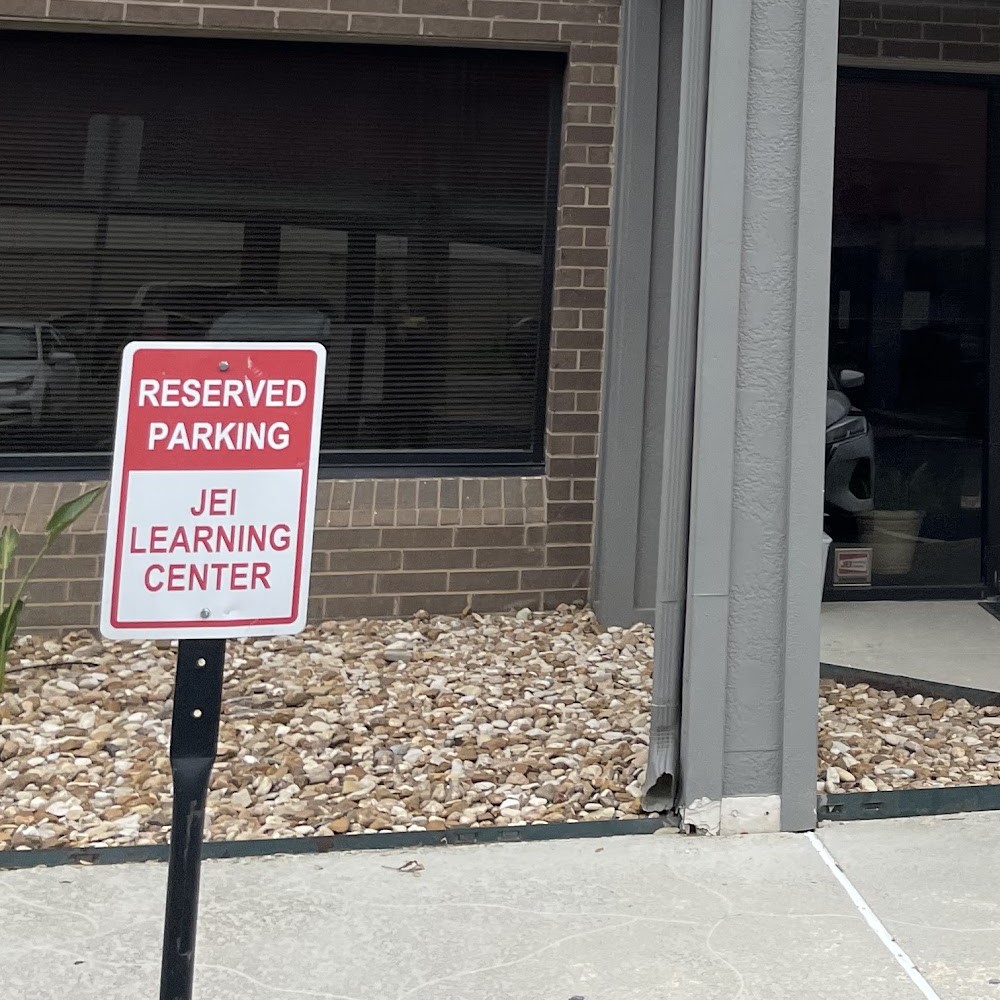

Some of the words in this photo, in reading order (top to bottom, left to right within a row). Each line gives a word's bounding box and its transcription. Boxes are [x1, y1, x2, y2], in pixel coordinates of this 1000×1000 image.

[138, 378, 307, 408] RESERVED
[147, 421, 291, 451] PARKING
[190, 488, 237, 517] JEI
[130, 523, 291, 554] LEARNING
[144, 562, 272, 592] CENTER
